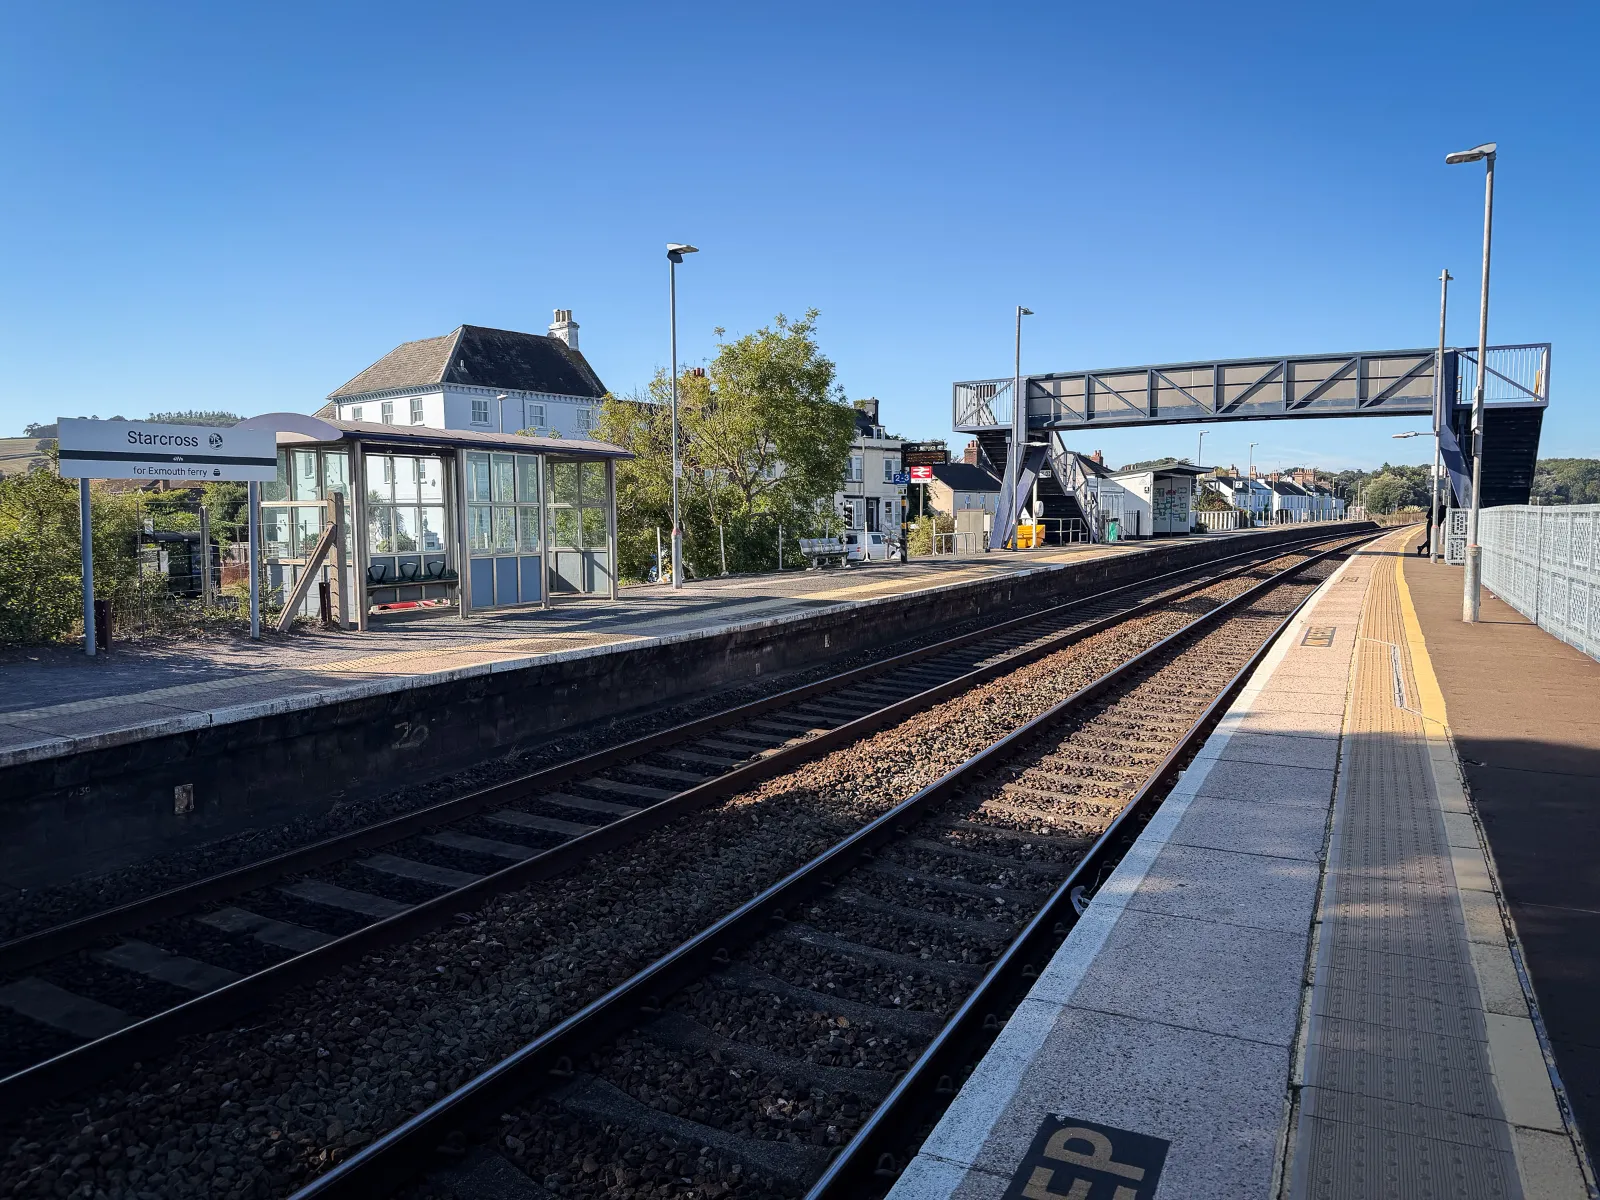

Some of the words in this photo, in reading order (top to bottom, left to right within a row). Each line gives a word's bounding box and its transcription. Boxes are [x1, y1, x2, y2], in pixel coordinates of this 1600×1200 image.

[127, 430, 199, 447] Starcross
[133, 466, 147, 475] for
[148, 466, 186, 476] Exmouth
[187, 468, 208, 477] ferry
